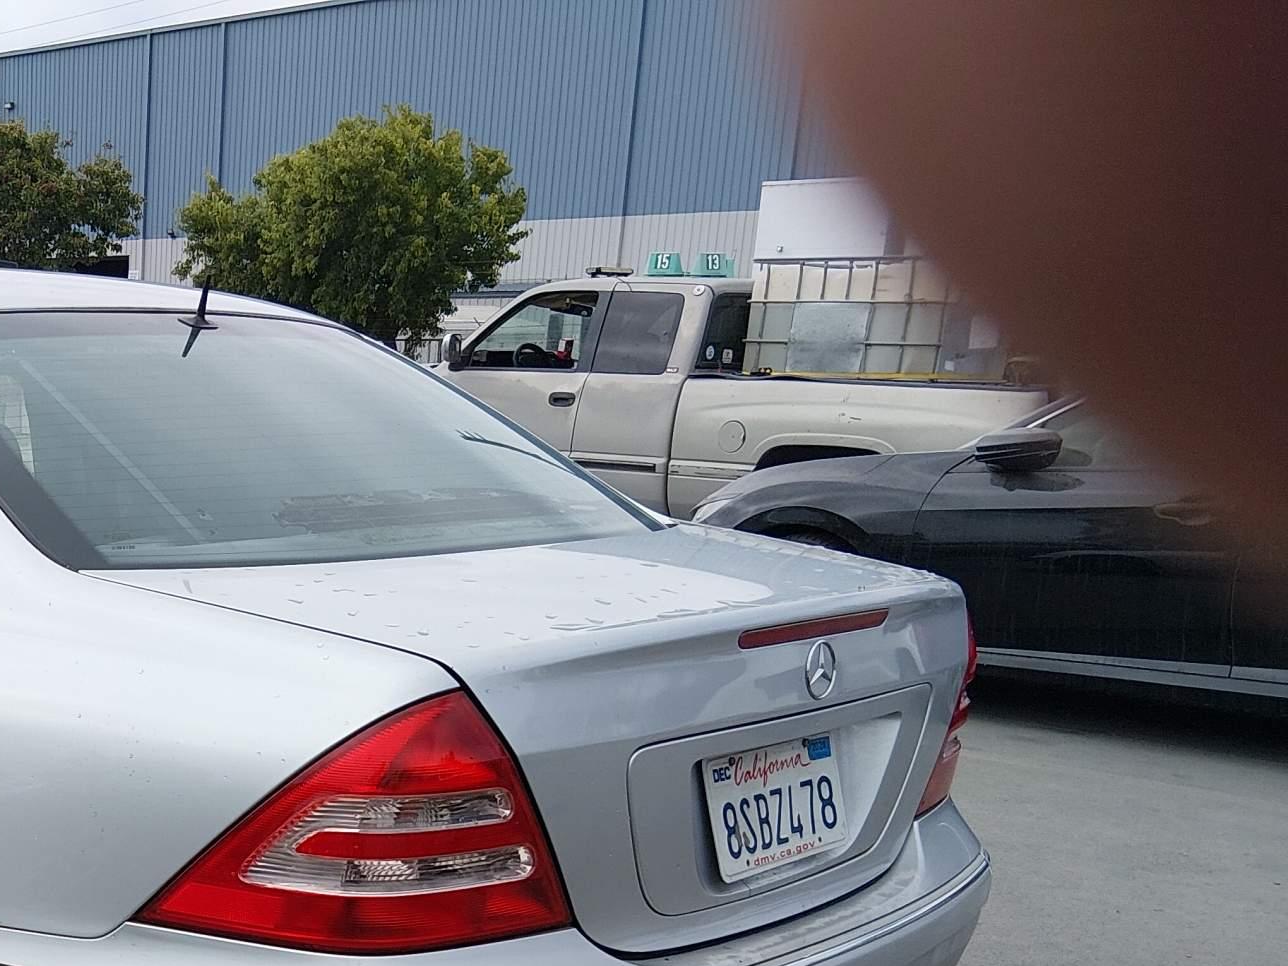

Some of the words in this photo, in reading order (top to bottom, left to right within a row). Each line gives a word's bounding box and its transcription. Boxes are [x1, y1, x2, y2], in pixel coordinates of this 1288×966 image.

[656, 253, 670, 269] 15
[707, 254, 720, 270] 13
[712, 765, 732, 783] DEC
[732, 750, 811, 788] California
[722, 775, 838, 860] 8SBZ478
[753, 839, 816, 867] dmv.ca.gov
